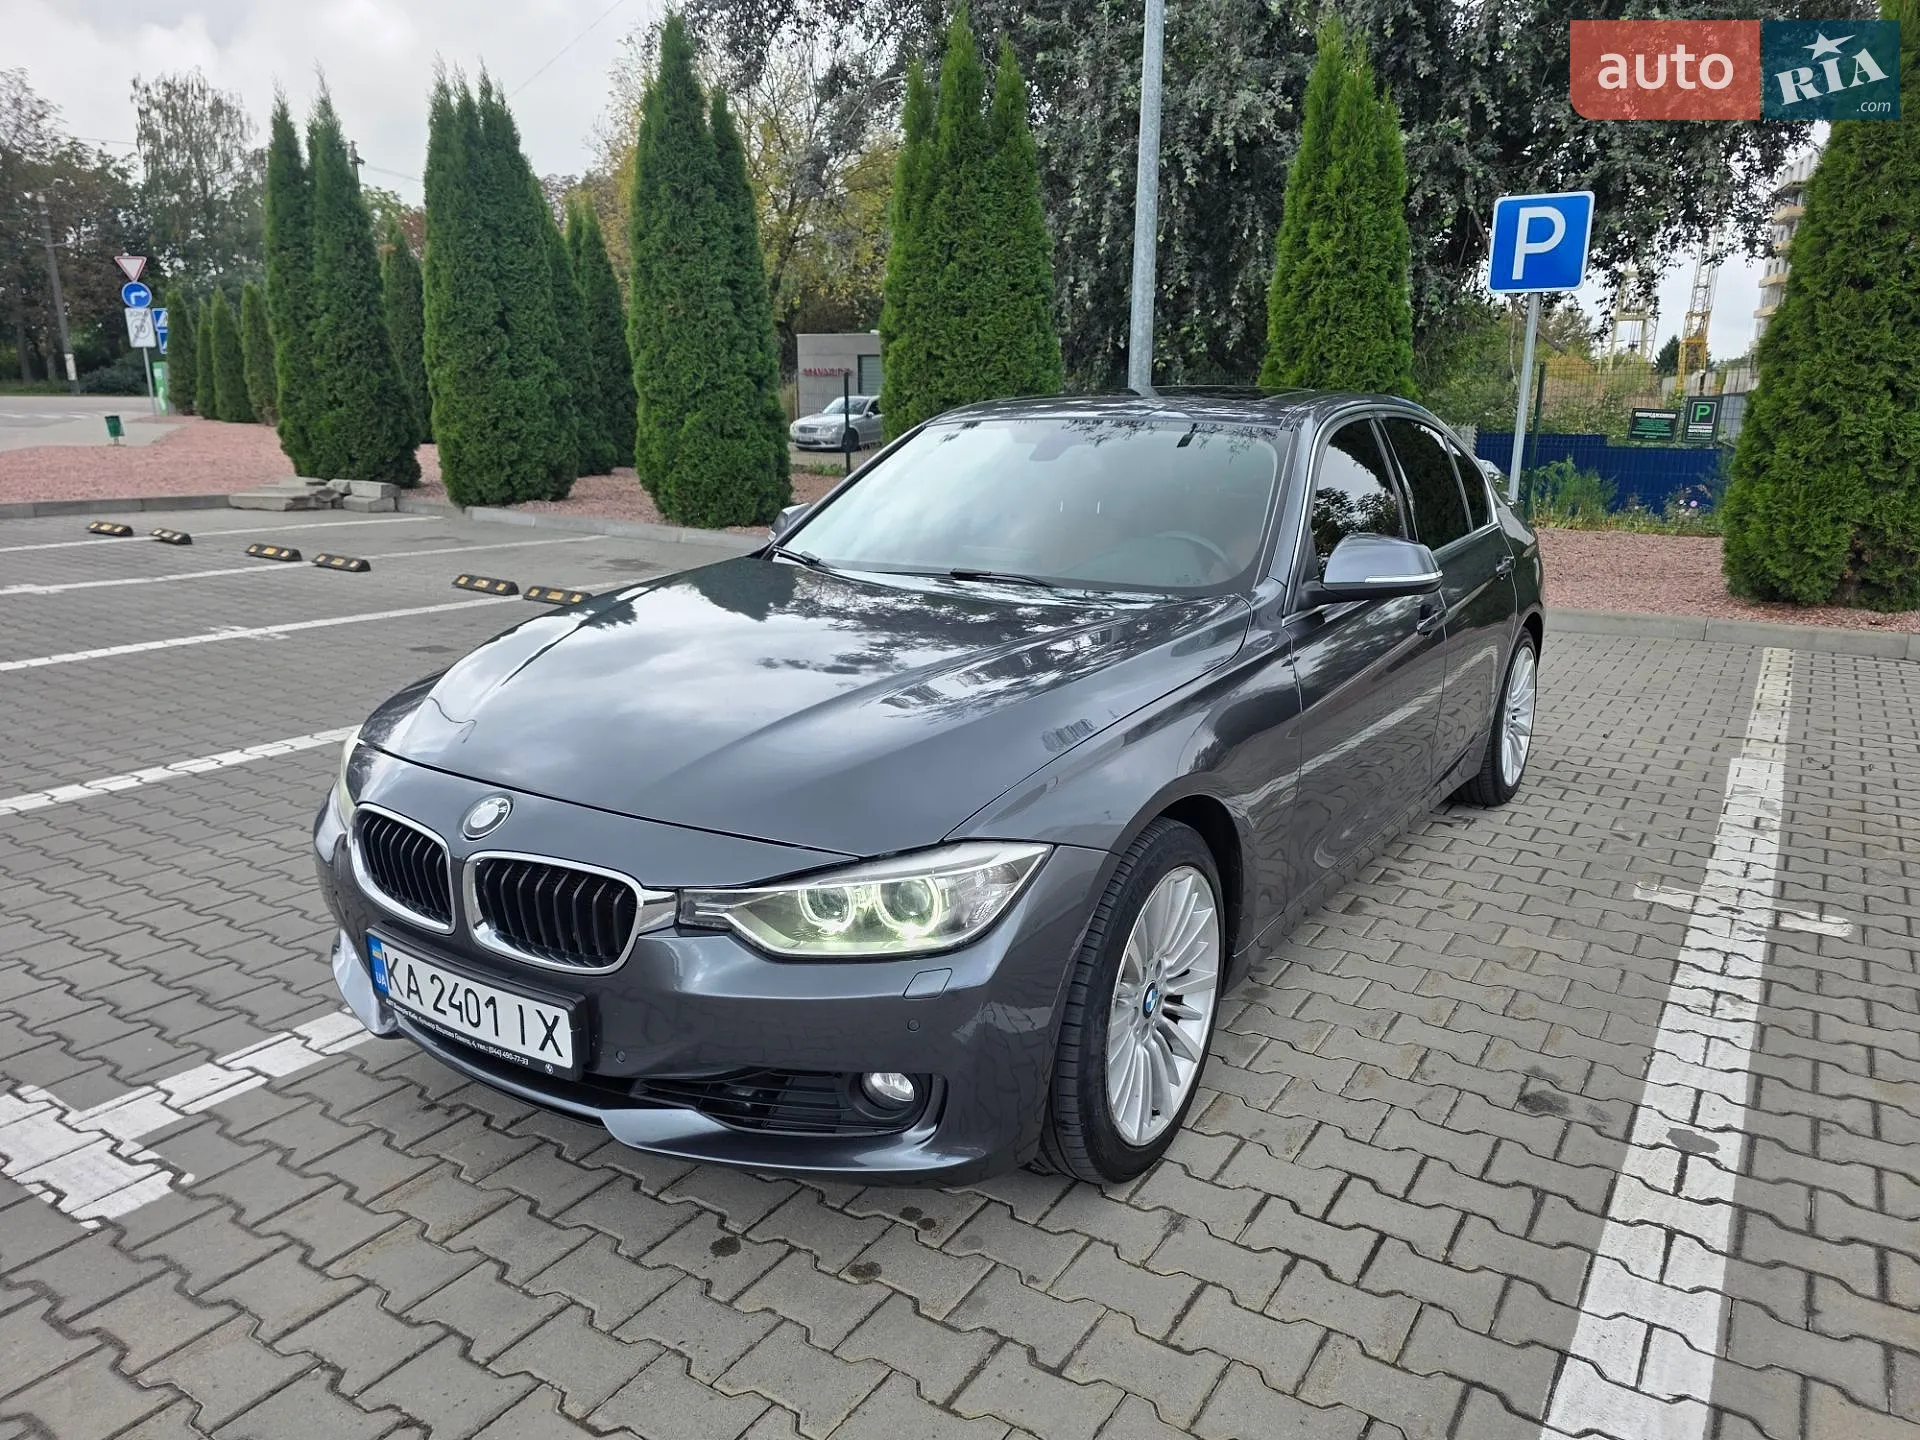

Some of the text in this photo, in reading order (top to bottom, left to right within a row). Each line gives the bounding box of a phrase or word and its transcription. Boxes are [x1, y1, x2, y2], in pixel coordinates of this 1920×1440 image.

[1512, 206, 1566, 280] P
[1695, 405, 1711, 422] P
[375, 973, 388, 988] UA
[384, 951, 564, 1058] KA 2401 IX
